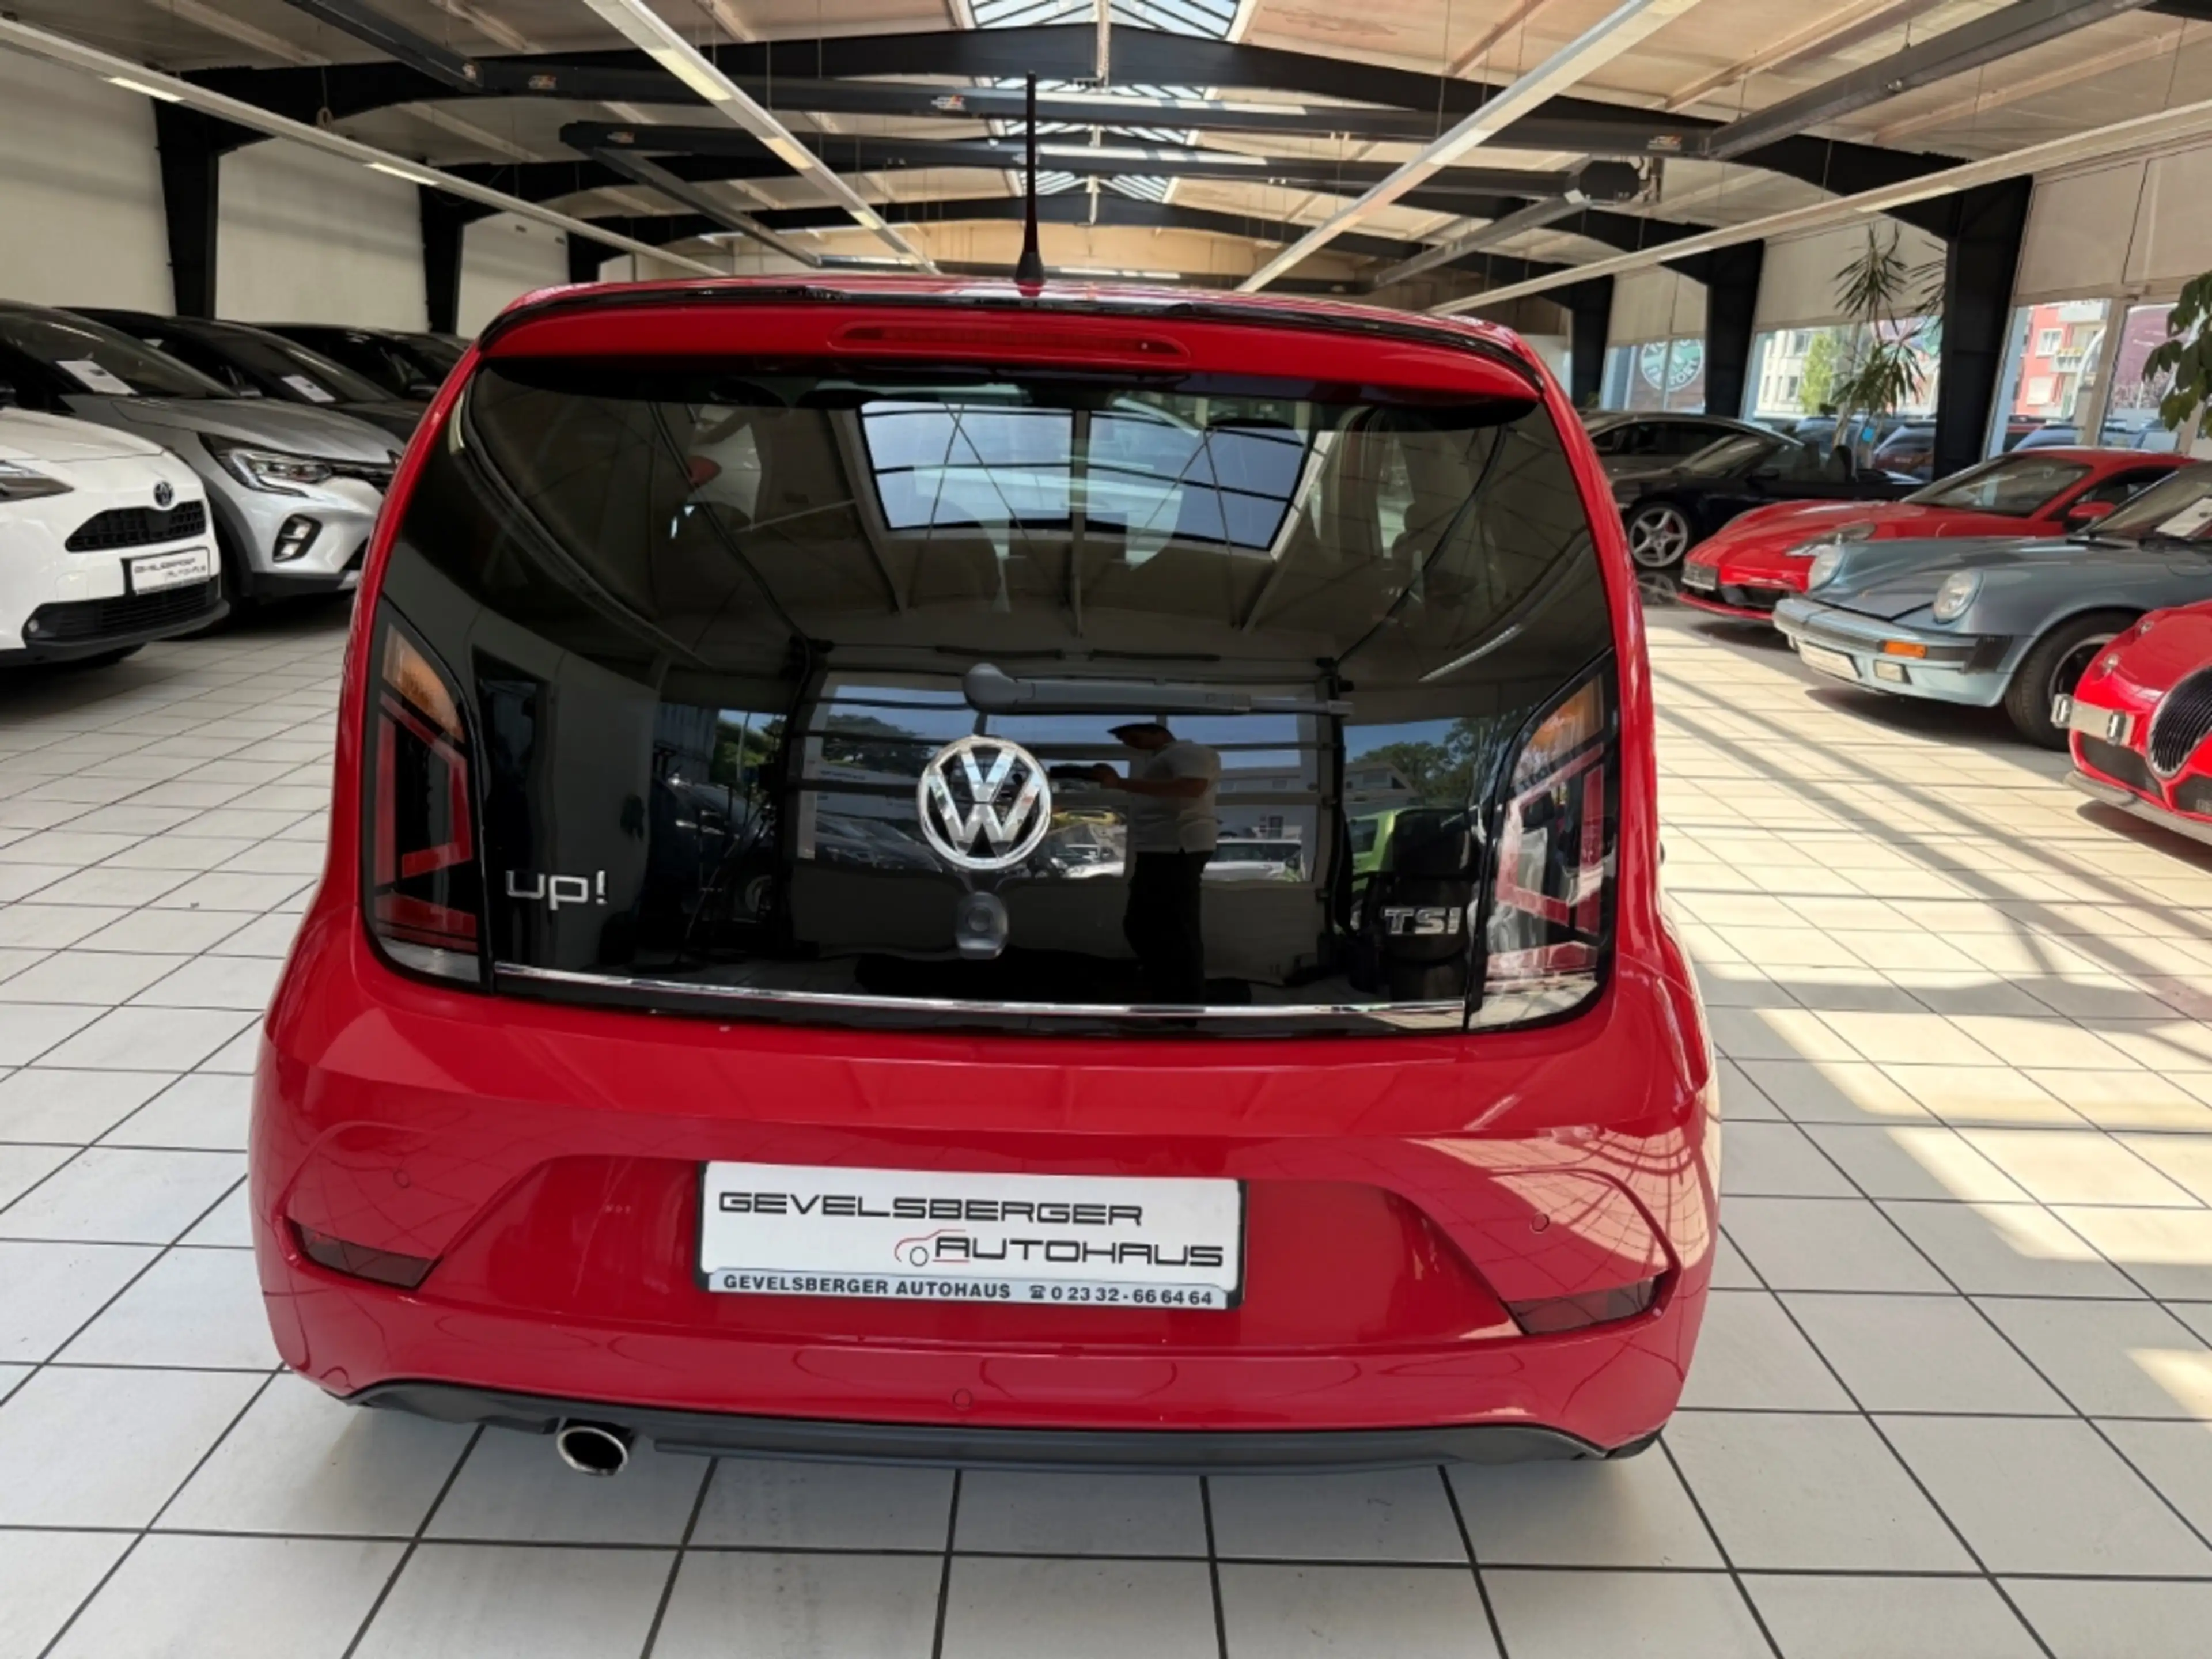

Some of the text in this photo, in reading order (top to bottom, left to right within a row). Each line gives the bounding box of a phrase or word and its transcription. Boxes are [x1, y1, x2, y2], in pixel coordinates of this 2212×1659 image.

[918, 736, 1051, 869] VW
[506, 870, 607, 910] up!
[1384, 907, 1462, 934] TSI
[718, 1191, 1143, 1226] GEVELSBERGER
[934, 1237, 1224, 1268] AUTOHAUS
[723, 1274, 888, 1296] GEVELSBERGER
[895, 1281, 1011, 1299] AUTOHAUS
